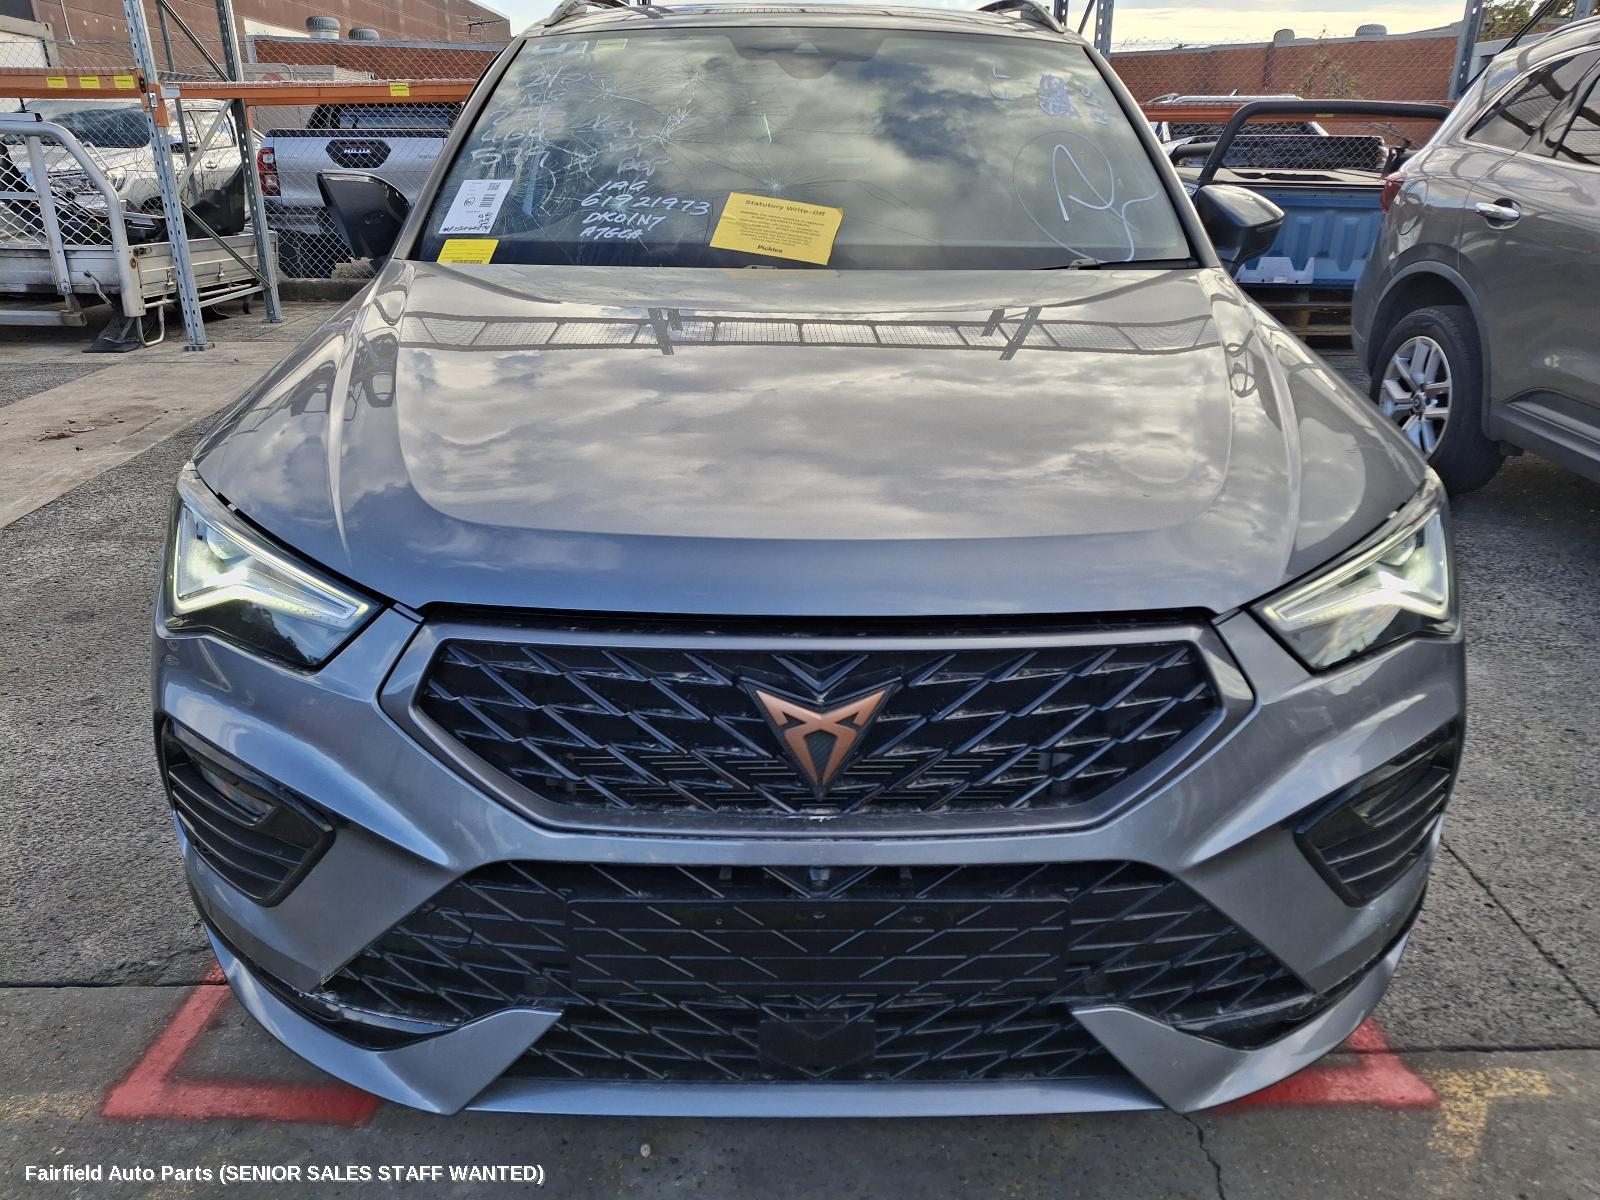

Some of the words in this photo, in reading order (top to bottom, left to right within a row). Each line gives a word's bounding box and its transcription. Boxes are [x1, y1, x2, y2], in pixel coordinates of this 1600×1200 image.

[581, 193, 710, 215] 61921973
[745, 199, 784, 211] Statutory
[786, 205, 826, 217] Write-Off
[757, 244, 783, 254] Pickles
